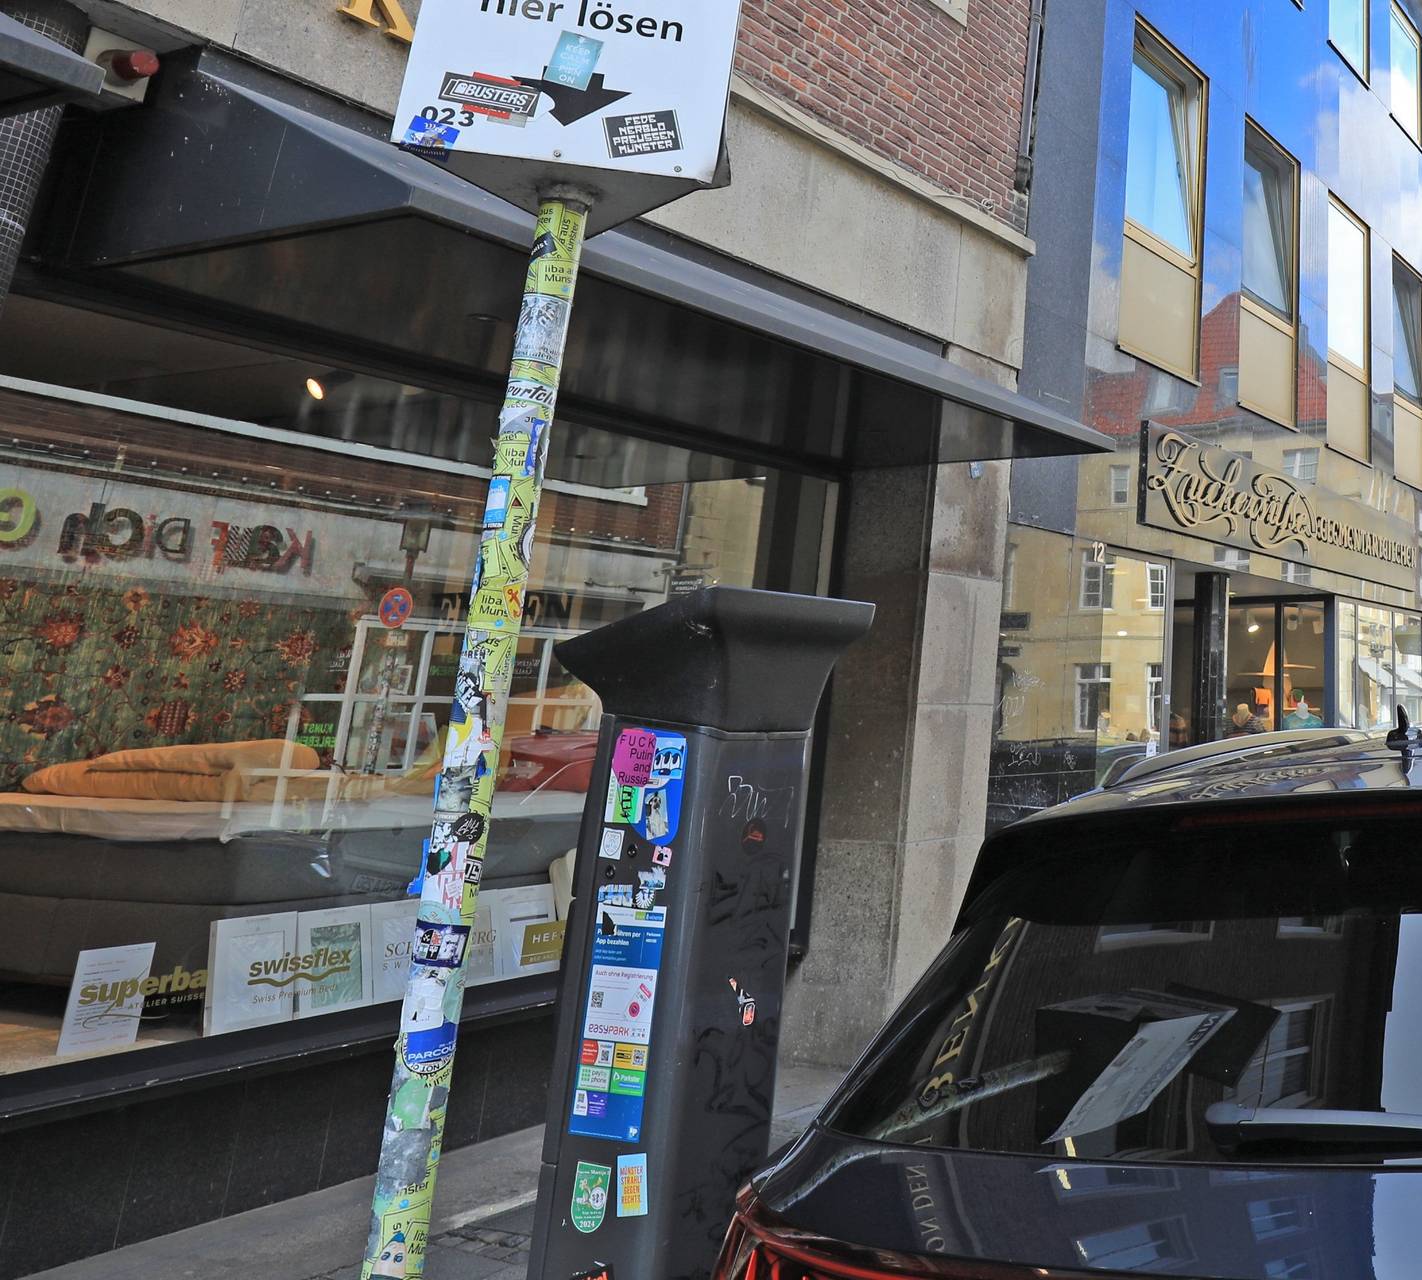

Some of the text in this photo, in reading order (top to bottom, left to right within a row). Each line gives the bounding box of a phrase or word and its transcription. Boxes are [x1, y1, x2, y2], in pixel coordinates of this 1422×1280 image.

[577, 0, 684, 42] lösen
[465, 83, 529, 106] BUSTERS
[420, 106, 475, 127] 023
[624, 114, 657, 126] FEDE
[618, 122, 666, 136] NERBLO
[612, 130, 675, 146] PREUSSEN
[1092, 541, 1105, 562] 12
[481, 595, 503, 606] liba
[620, 734, 656, 749] FUCK
[630, 748, 653, 760] Putin
[634, 762, 651, 773] and
[618, 771, 648, 785] Russia
[248, 946, 353, 978] swissflex
[78, 965, 209, 1008] superba
[252, 993, 276, 1004] Swiss
